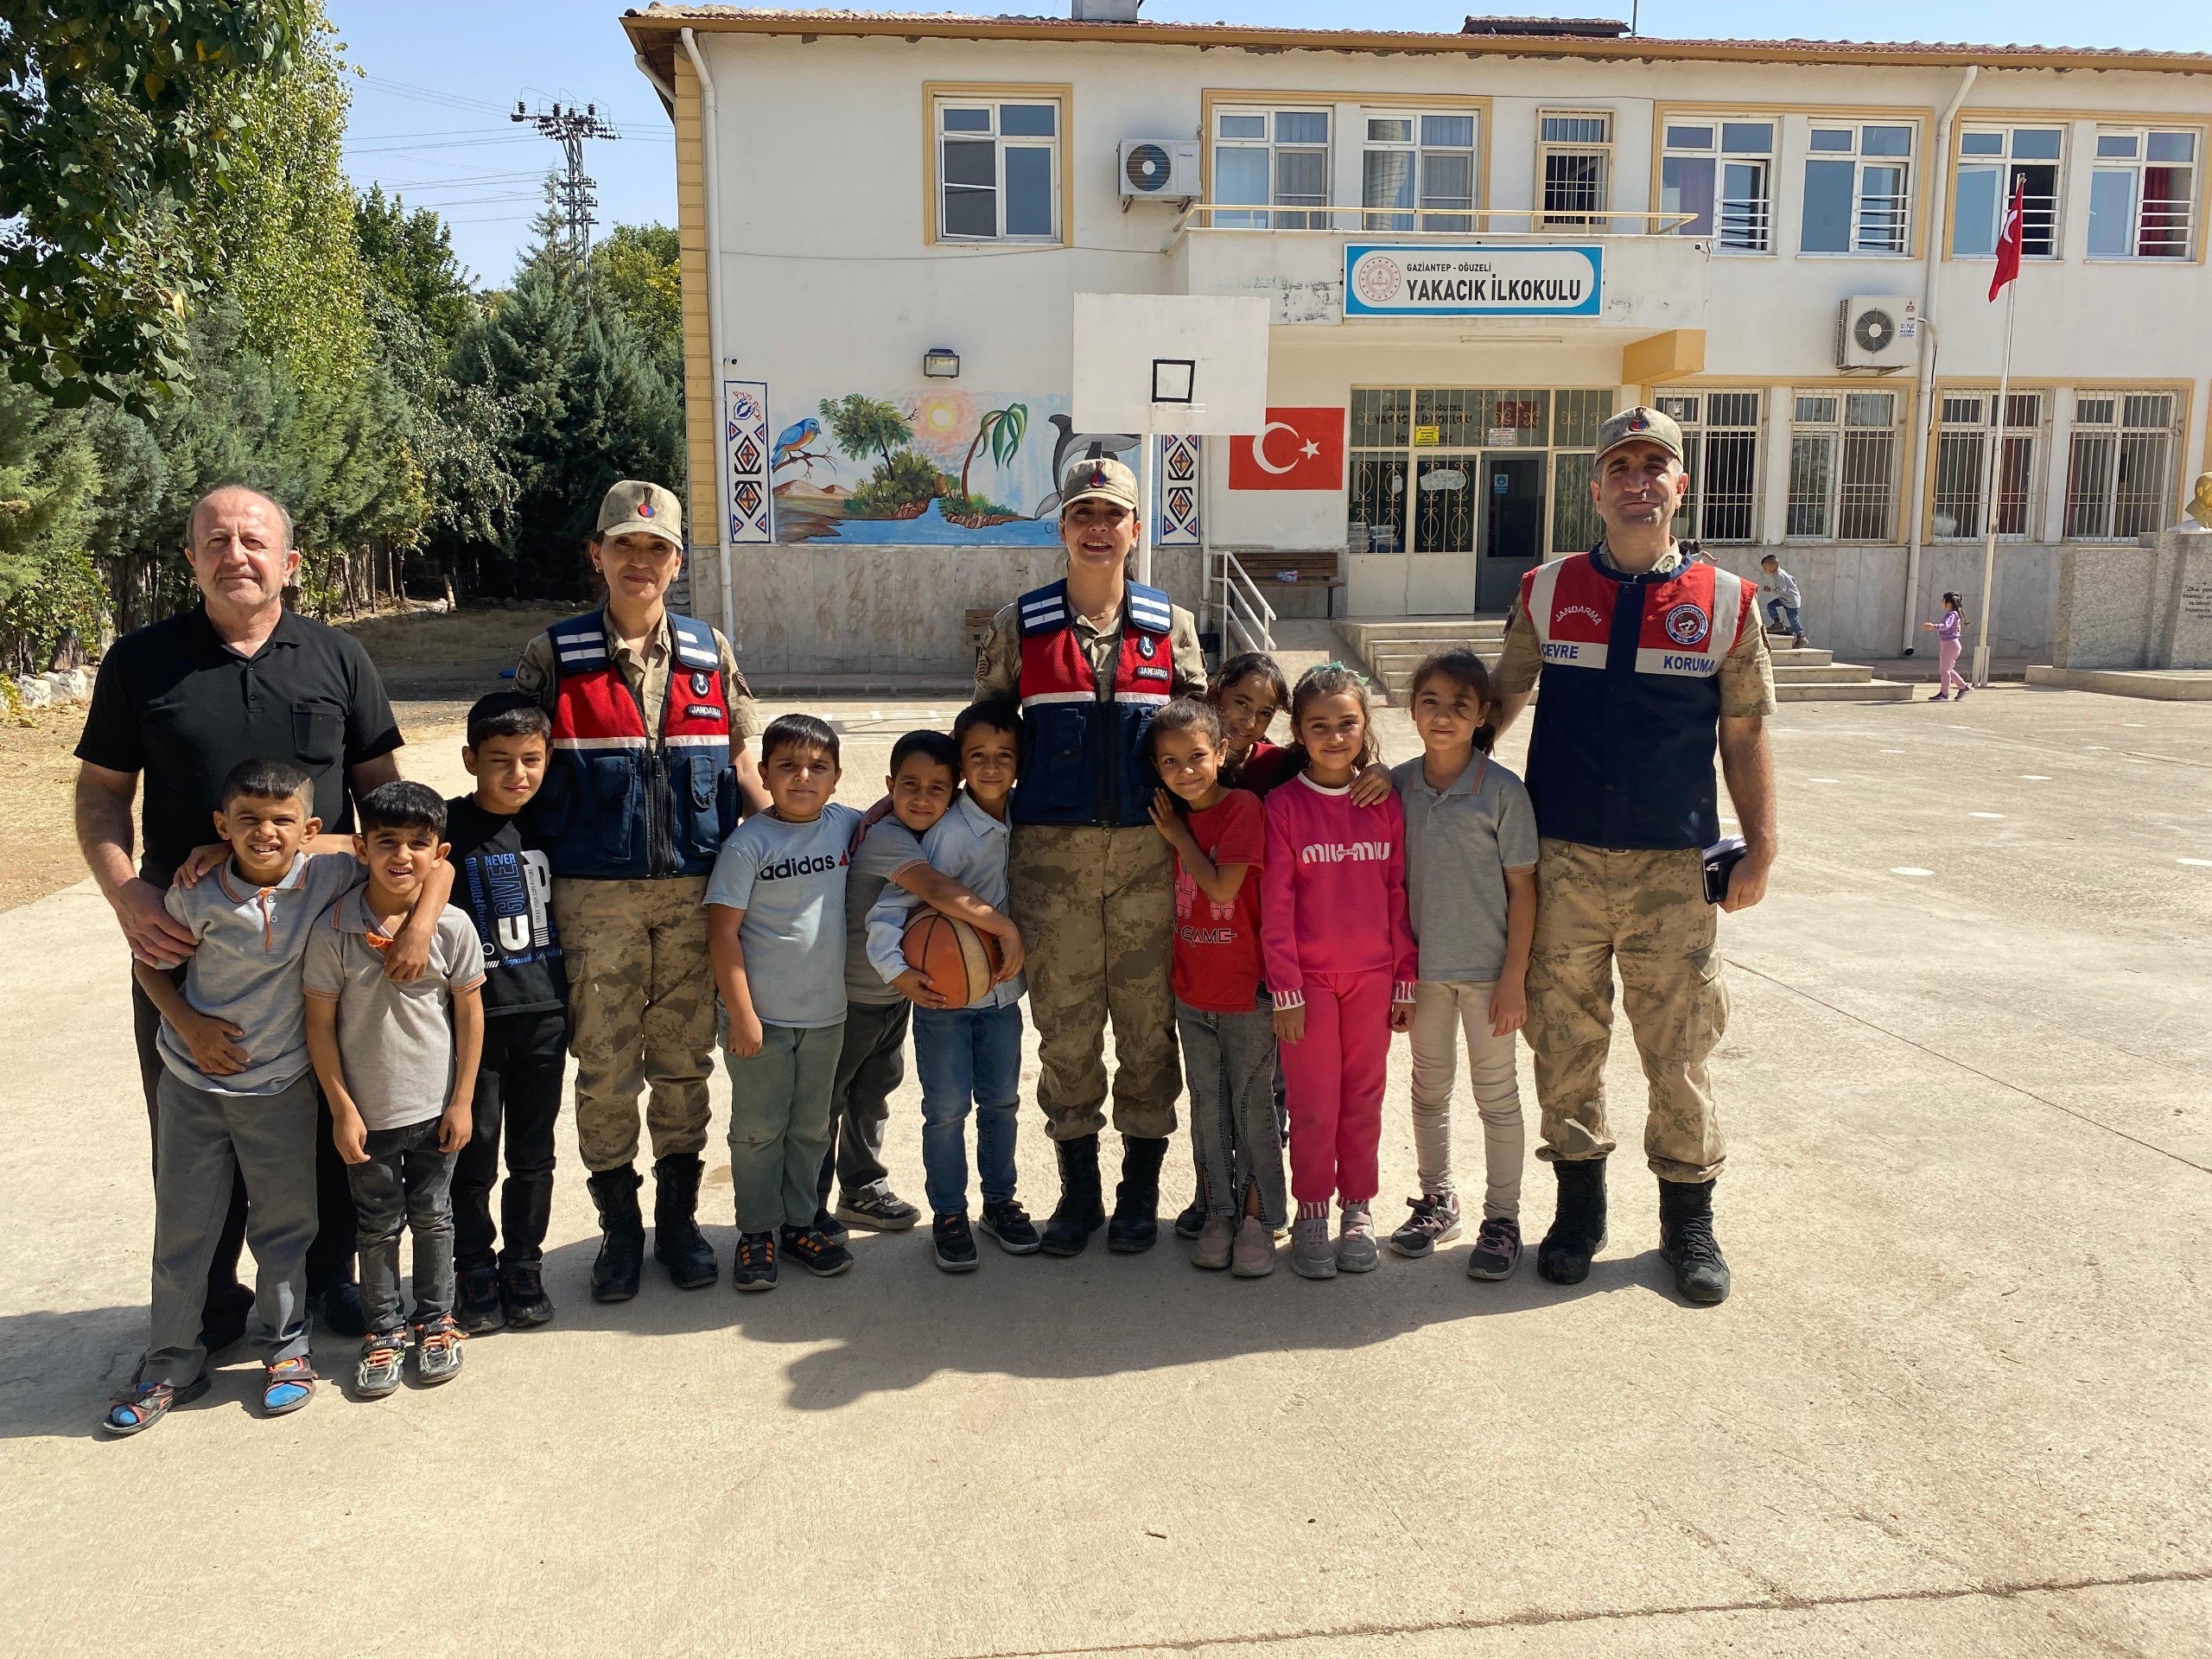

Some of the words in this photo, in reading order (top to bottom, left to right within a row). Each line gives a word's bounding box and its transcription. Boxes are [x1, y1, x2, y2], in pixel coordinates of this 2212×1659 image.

[1407, 262, 1451, 272] GAZİANTEP
[1459, 262, 1491, 272] OĞUZELİ
[1407, 279, 1486, 301] YAKACIK
[1491, 274, 1581, 301] İLKOKULU
[1555, 606, 1602, 626] JANDARMA
[1663, 655, 1715, 673] KORUMA
[485, 853, 516, 867] NEVER
[760, 855, 836, 880] adidas
[486, 863, 526, 917] GIVE
